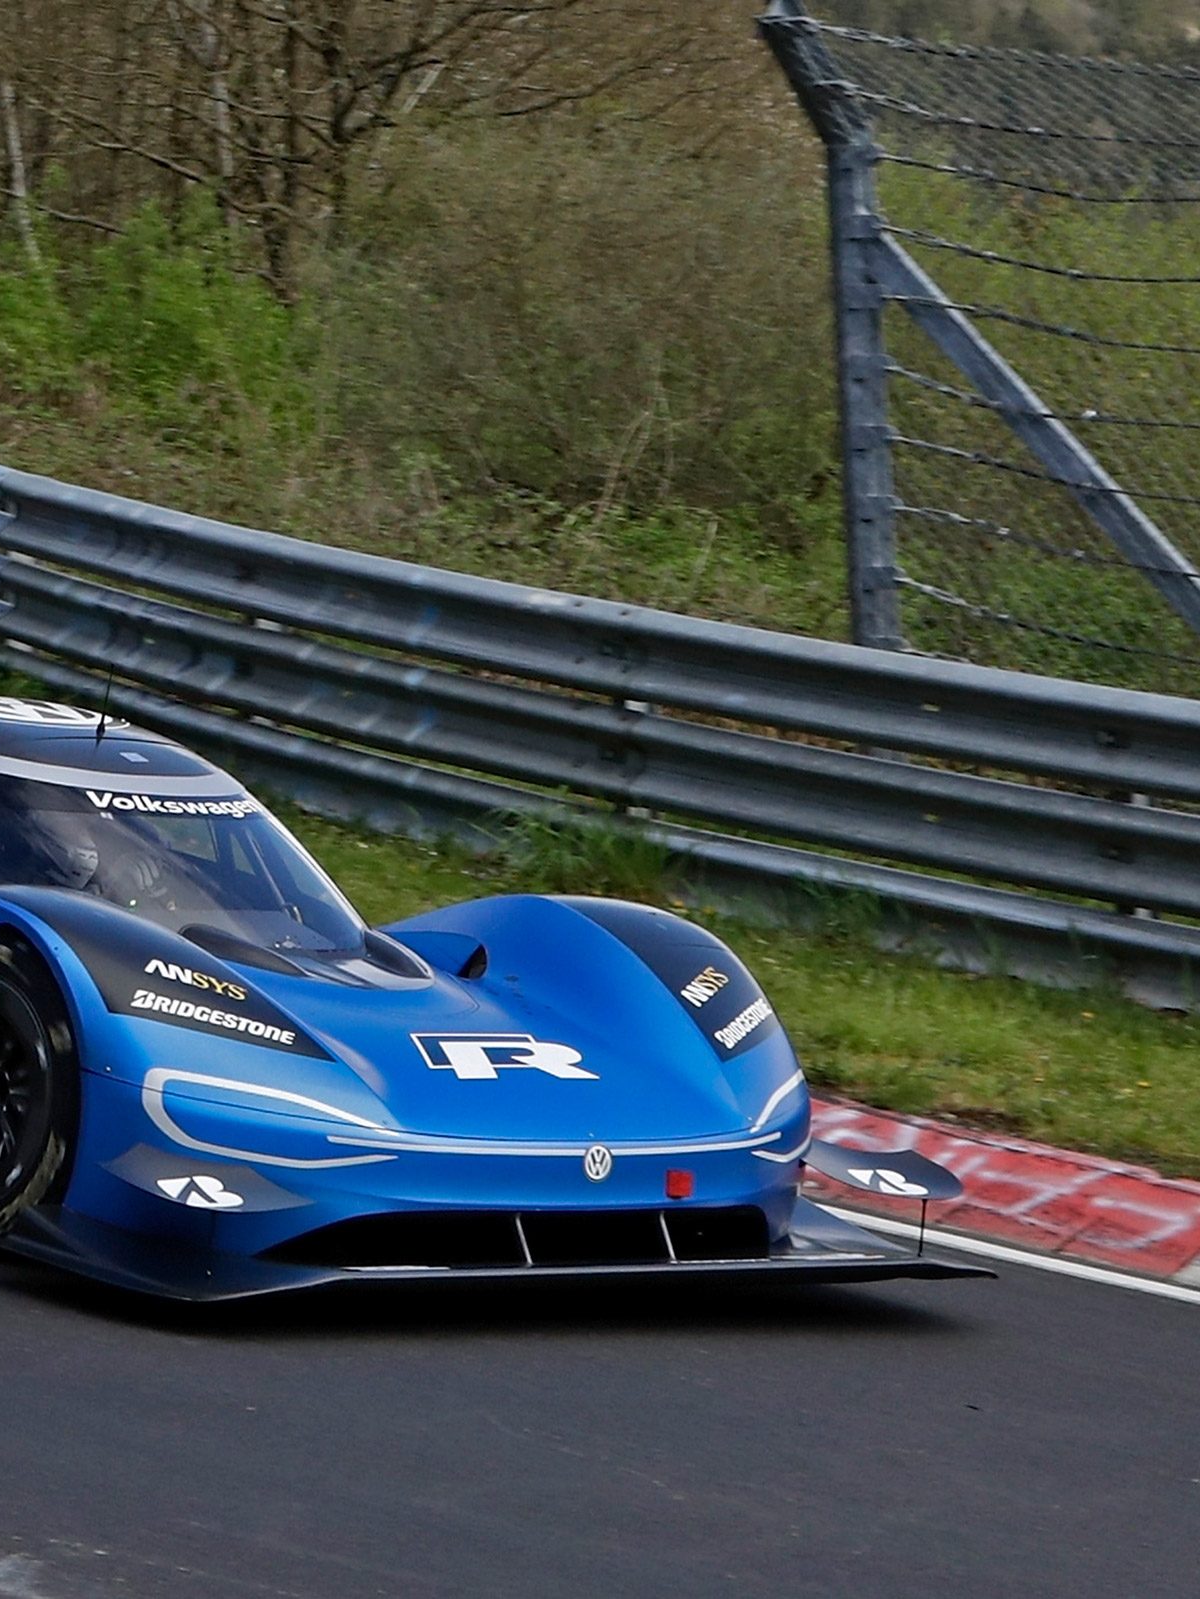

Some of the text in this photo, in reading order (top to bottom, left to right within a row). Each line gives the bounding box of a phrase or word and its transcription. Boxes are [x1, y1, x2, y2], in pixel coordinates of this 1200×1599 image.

[85, 790, 261, 819] Volkswagen
[144, 958, 248, 1001] ANSYS
[680, 966, 730, 1008] ANSYS
[130, 989, 296, 1045] BRIDGESTONE
[714, 997, 773, 1050] BRIDGESTONE
[409, 1033, 600, 1080] R
